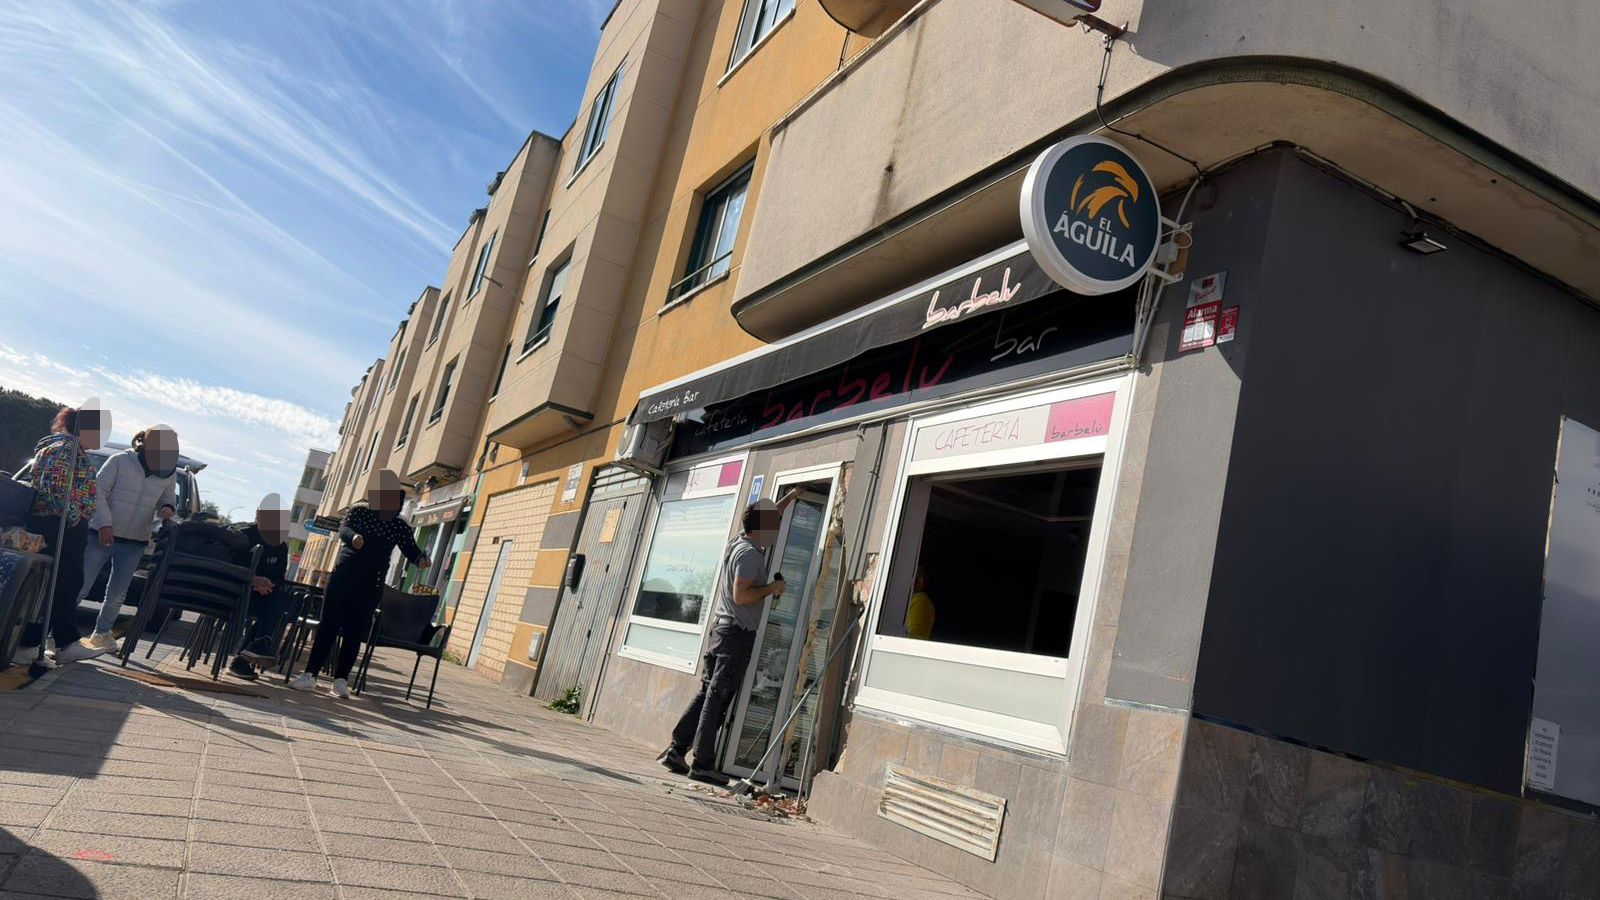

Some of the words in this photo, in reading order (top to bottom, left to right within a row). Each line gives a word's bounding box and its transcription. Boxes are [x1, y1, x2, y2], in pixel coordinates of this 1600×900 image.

[1099, 216, 1112, 233] EL
[1053, 210, 1136, 268] ÁGUILA
[1186, 305, 1218, 320] Alarma
[990, 311, 1058, 362] bar
[683, 390, 700, 405] Bar
